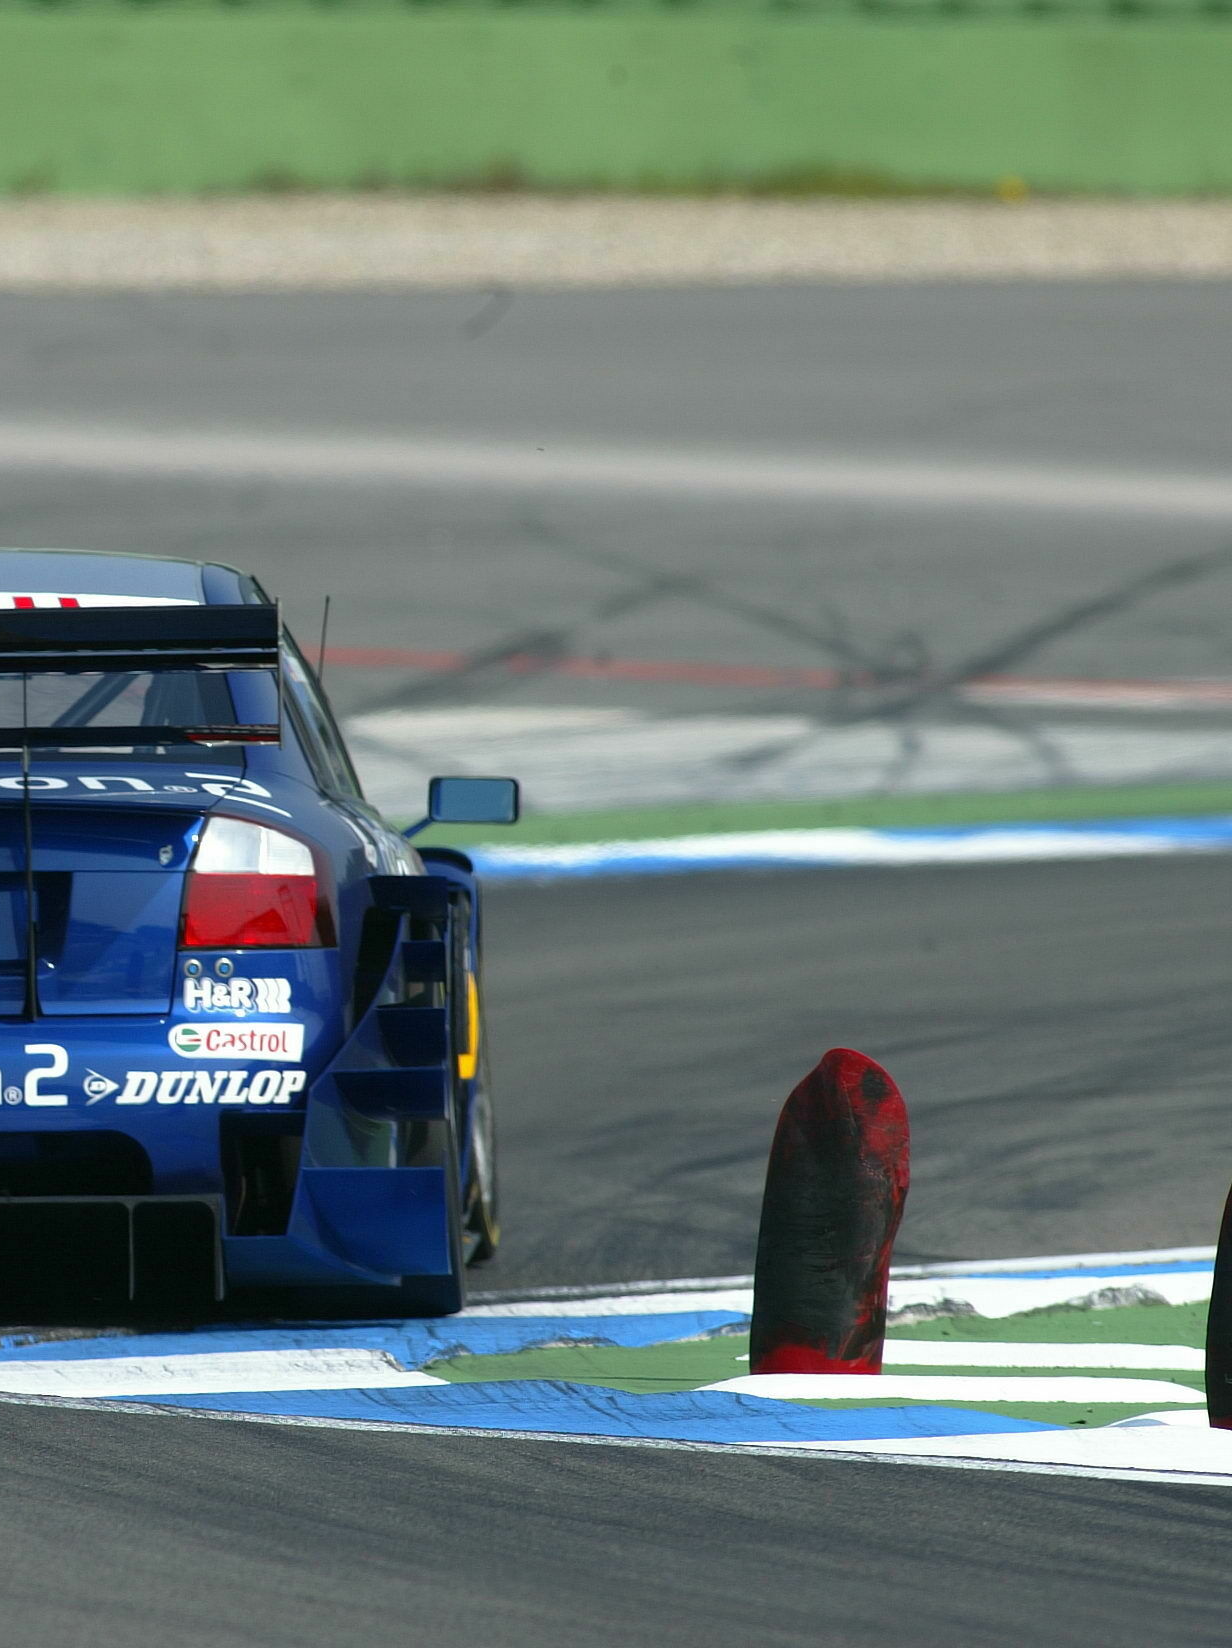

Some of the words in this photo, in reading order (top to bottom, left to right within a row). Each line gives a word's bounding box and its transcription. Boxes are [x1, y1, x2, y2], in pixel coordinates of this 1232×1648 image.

[184, 978, 259, 1012] H&R
[206, 1029, 288, 1053] Castrol
[116, 1069, 307, 1105] DUNLOP
